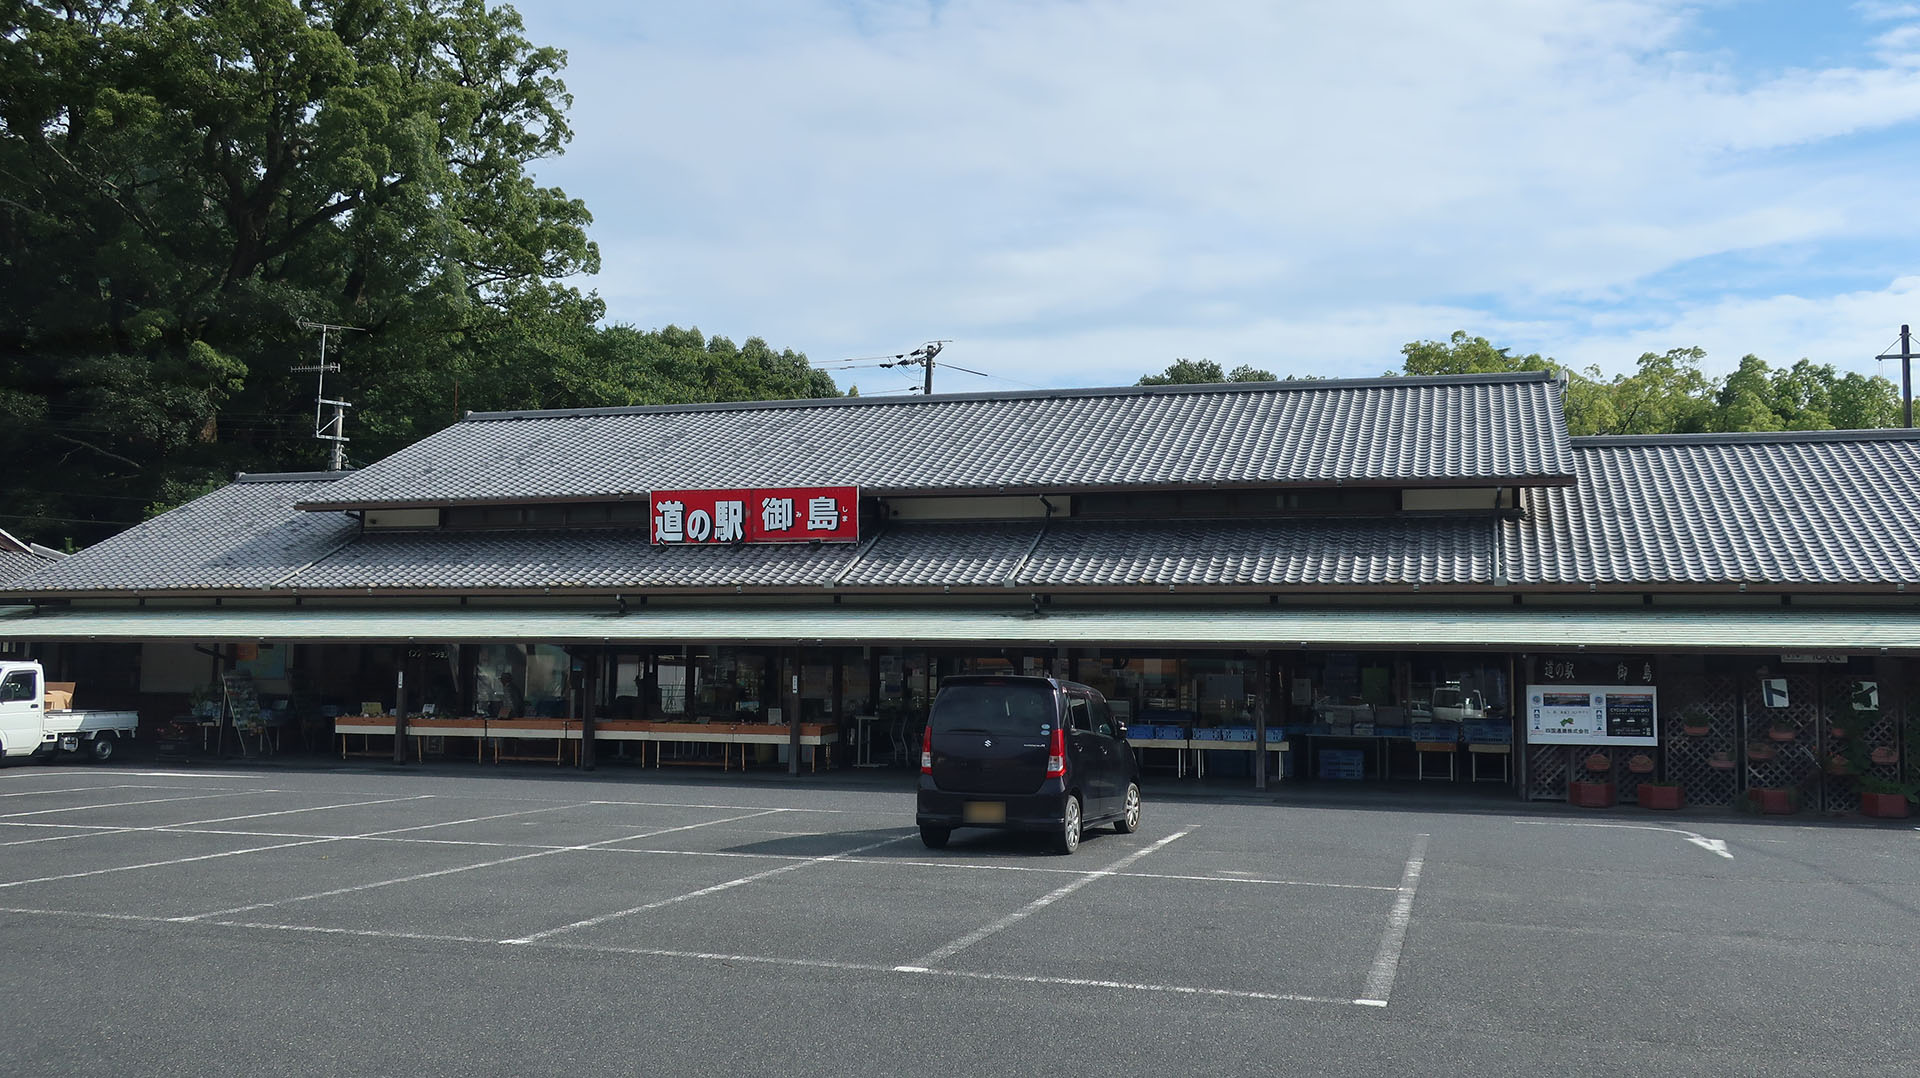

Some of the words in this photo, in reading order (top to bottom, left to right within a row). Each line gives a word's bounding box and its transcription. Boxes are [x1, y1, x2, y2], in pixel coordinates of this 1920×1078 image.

[655, 500, 744, 541] 道の駅
[1544, 660, 1576, 679] 道の駅
